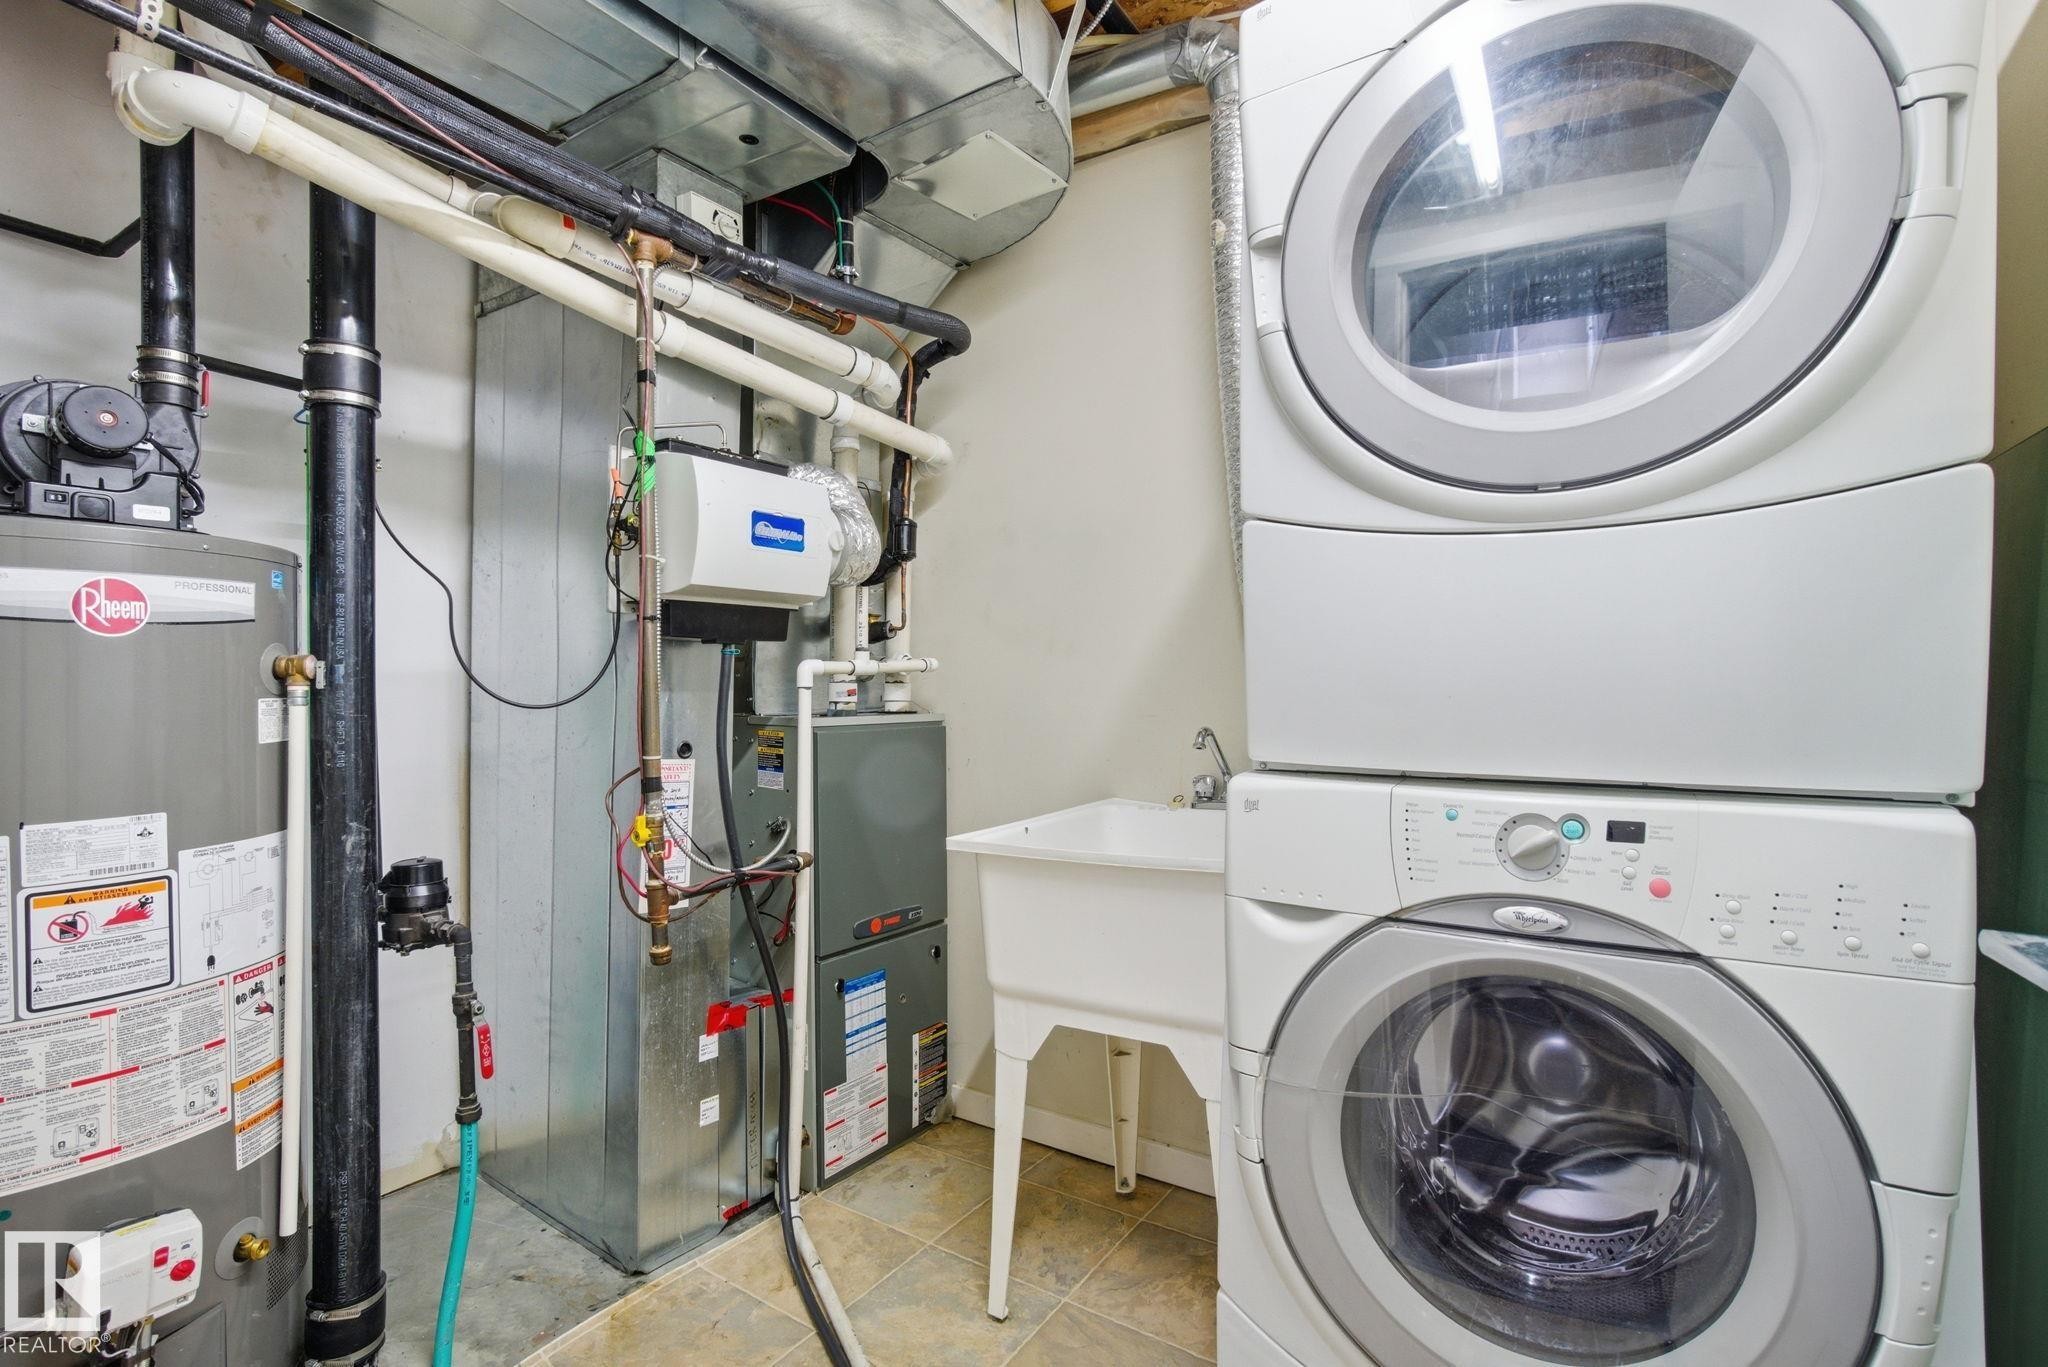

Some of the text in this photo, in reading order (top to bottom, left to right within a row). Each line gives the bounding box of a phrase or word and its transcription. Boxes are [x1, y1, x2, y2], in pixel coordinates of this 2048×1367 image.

[175, 581, 253, 595] PROFESSIONAL
[81, 578, 146, 627] Rheem
[336, 618, 346, 636] MADE
[92, 887, 128, 897] WARNING
[1512, 911, 1549, 926] Whirlpool
[244, 964, 273, 980] DANGER
